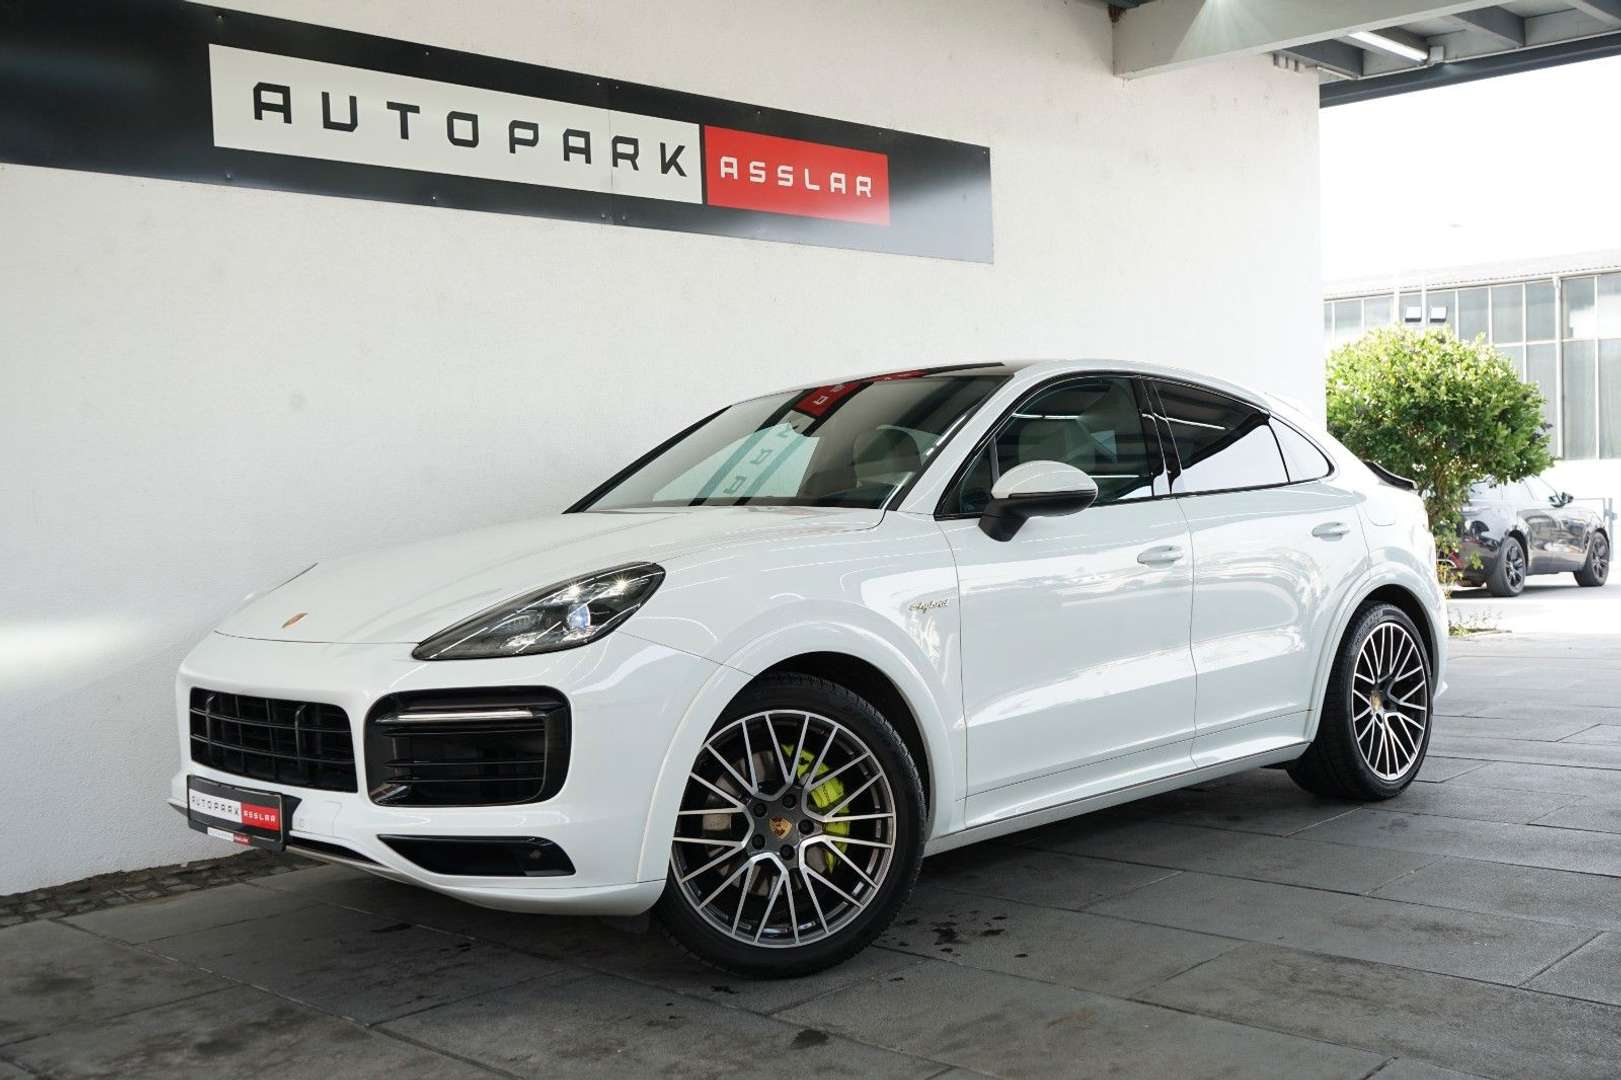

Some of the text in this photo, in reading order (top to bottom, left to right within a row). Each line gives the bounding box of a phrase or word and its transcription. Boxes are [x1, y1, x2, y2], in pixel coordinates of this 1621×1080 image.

[253, 82, 872, 198] AUTOPARK ASSLAR
[191, 795, 277, 823] AUTOPARK ASSLAR
